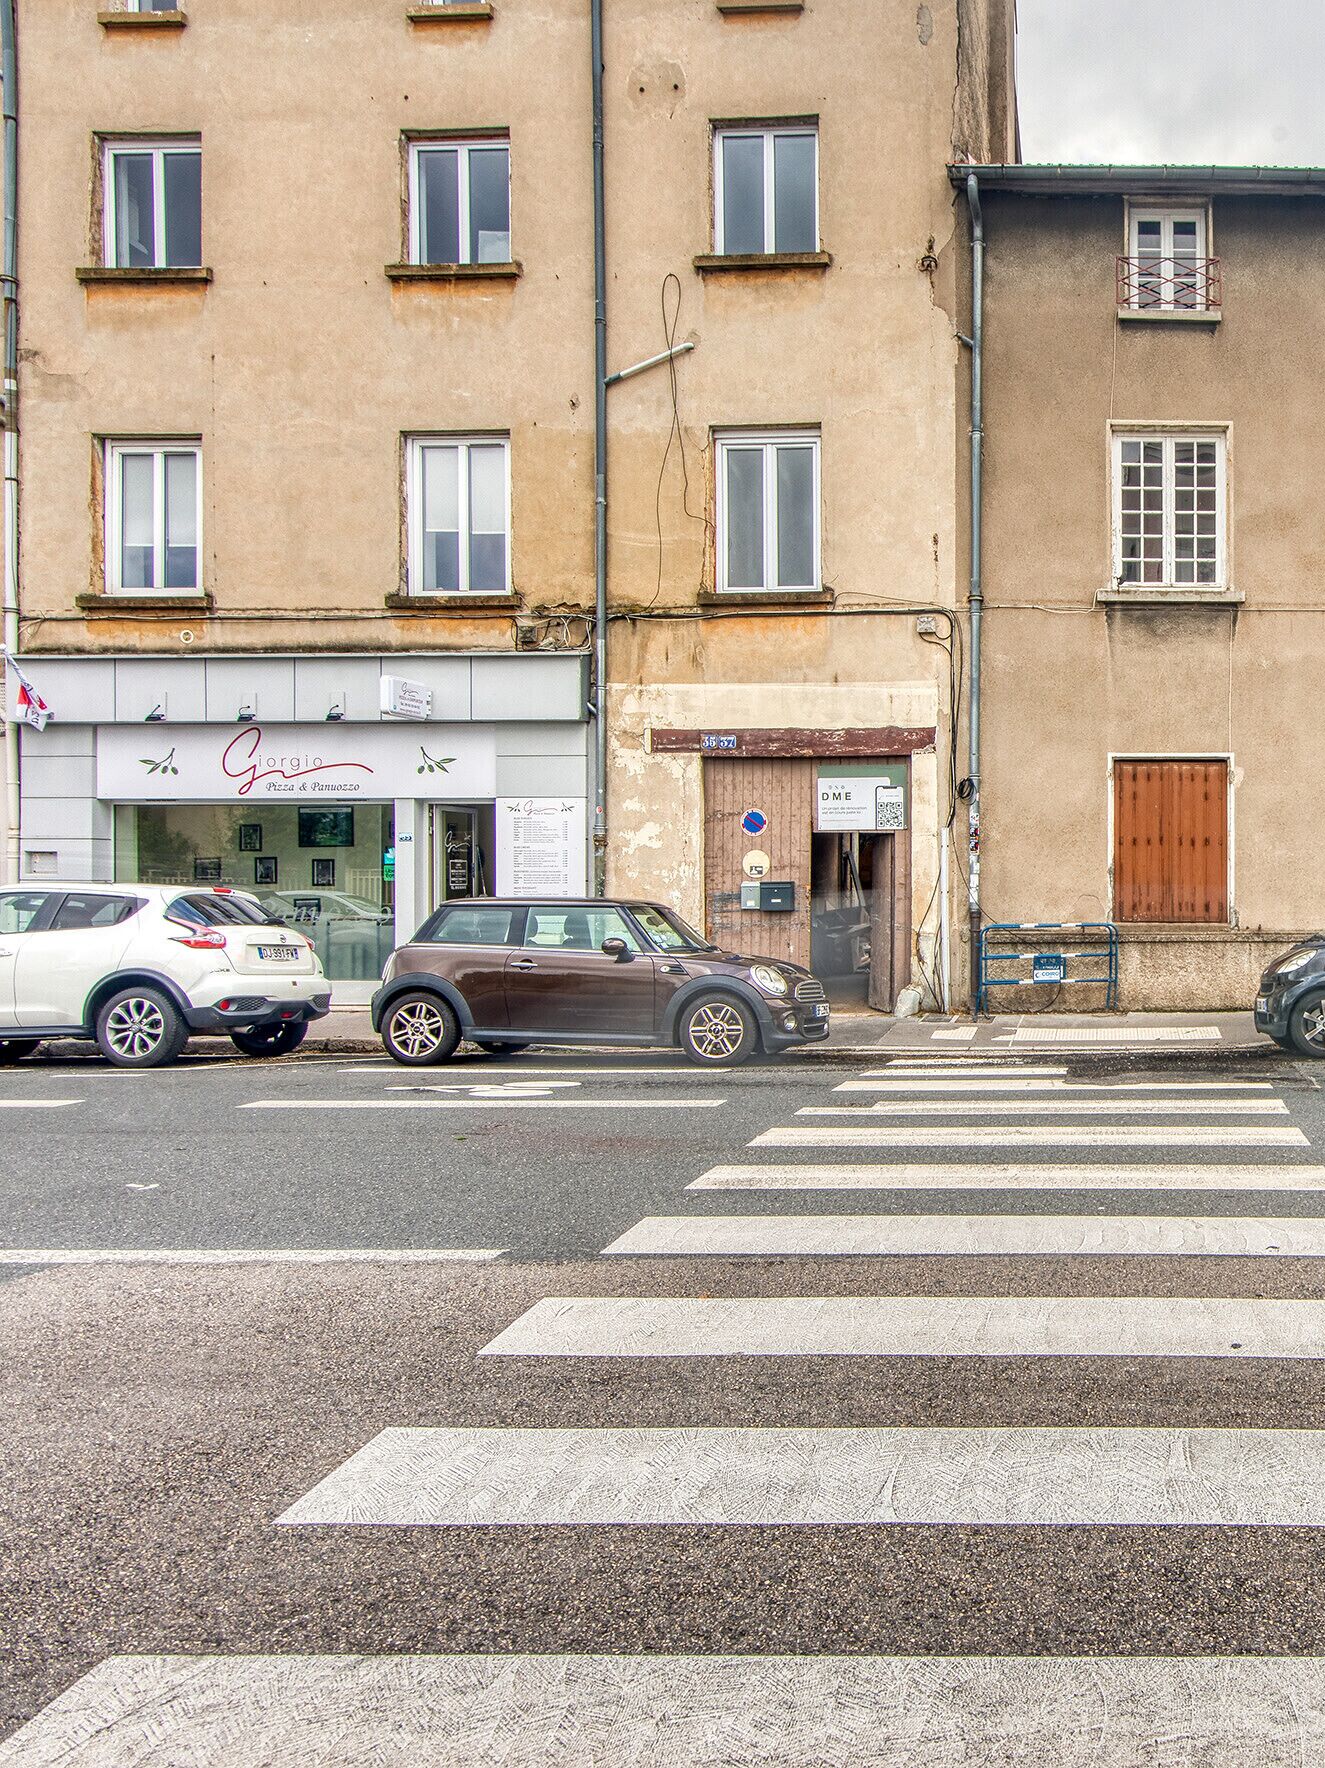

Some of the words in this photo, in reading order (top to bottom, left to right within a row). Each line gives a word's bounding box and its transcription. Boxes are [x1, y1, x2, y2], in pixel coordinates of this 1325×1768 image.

[720, 736, 735, 748] 37
[223, 727, 373, 795] Giorgio
[265, 782, 294, 792] Pizza
[299, 782, 307, 791] &
[311, 782, 360, 792] Panuozzo
[822, 792, 852, 801] DME
